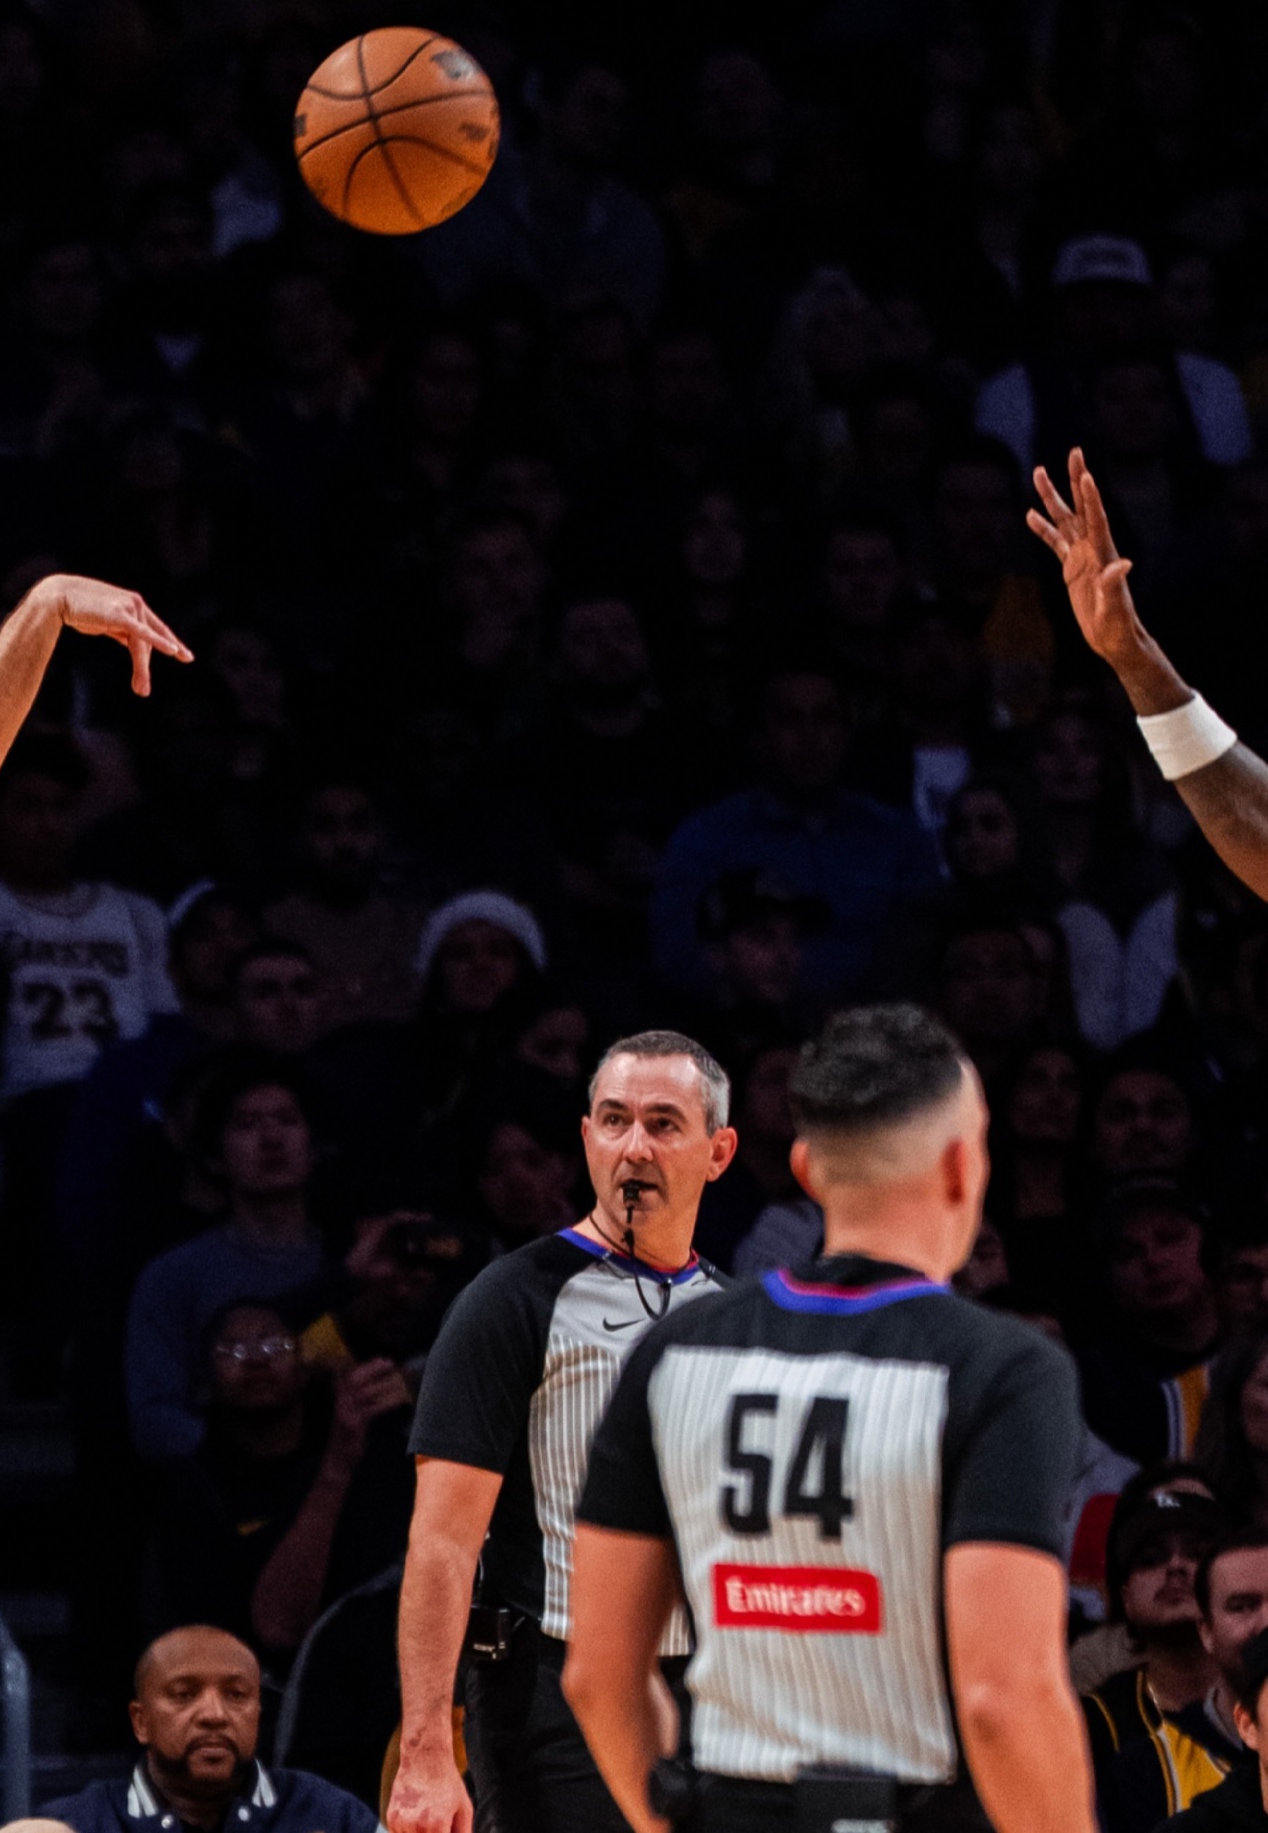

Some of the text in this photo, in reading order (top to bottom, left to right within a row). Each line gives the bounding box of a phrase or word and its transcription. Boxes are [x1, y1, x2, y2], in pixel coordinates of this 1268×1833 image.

[23, 978, 119, 1040] 23
[719, 1392, 855, 1544] 54
[725, 1575, 866, 1617] Emirates
